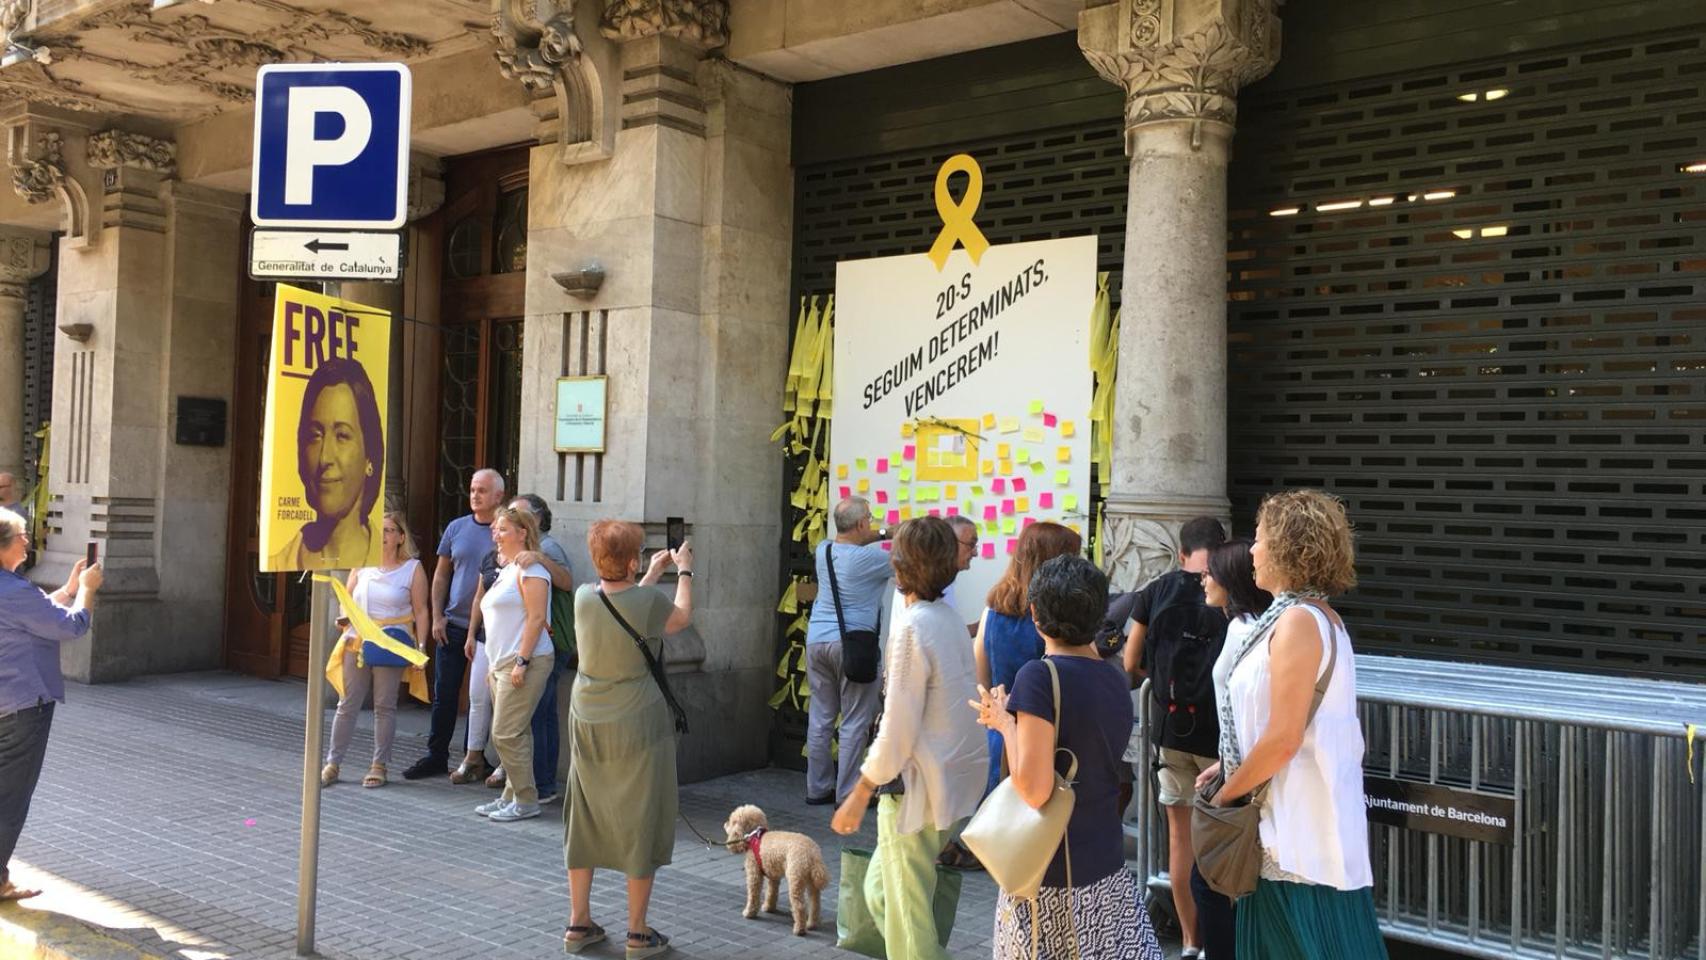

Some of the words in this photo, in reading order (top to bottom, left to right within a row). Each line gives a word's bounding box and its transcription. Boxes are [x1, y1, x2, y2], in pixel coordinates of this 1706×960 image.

[285, 86, 372, 205] P
[258, 260, 315, 273] Generalitat
[320, 262, 334, 273] de
[339, 261, 392, 275] Catalunya
[284, 300, 360, 370] FREE
[863, 346, 923, 410] SEGUIM
[904, 330, 999, 418] VENCEREM!
[277, 510, 314, 521] FORCADELL
[278, 496, 301, 507] CARME
[1363, 794, 1429, 815] Ajuntament
[1430, 804, 1446, 818] de
[1448, 806, 1507, 828] Barcelona
